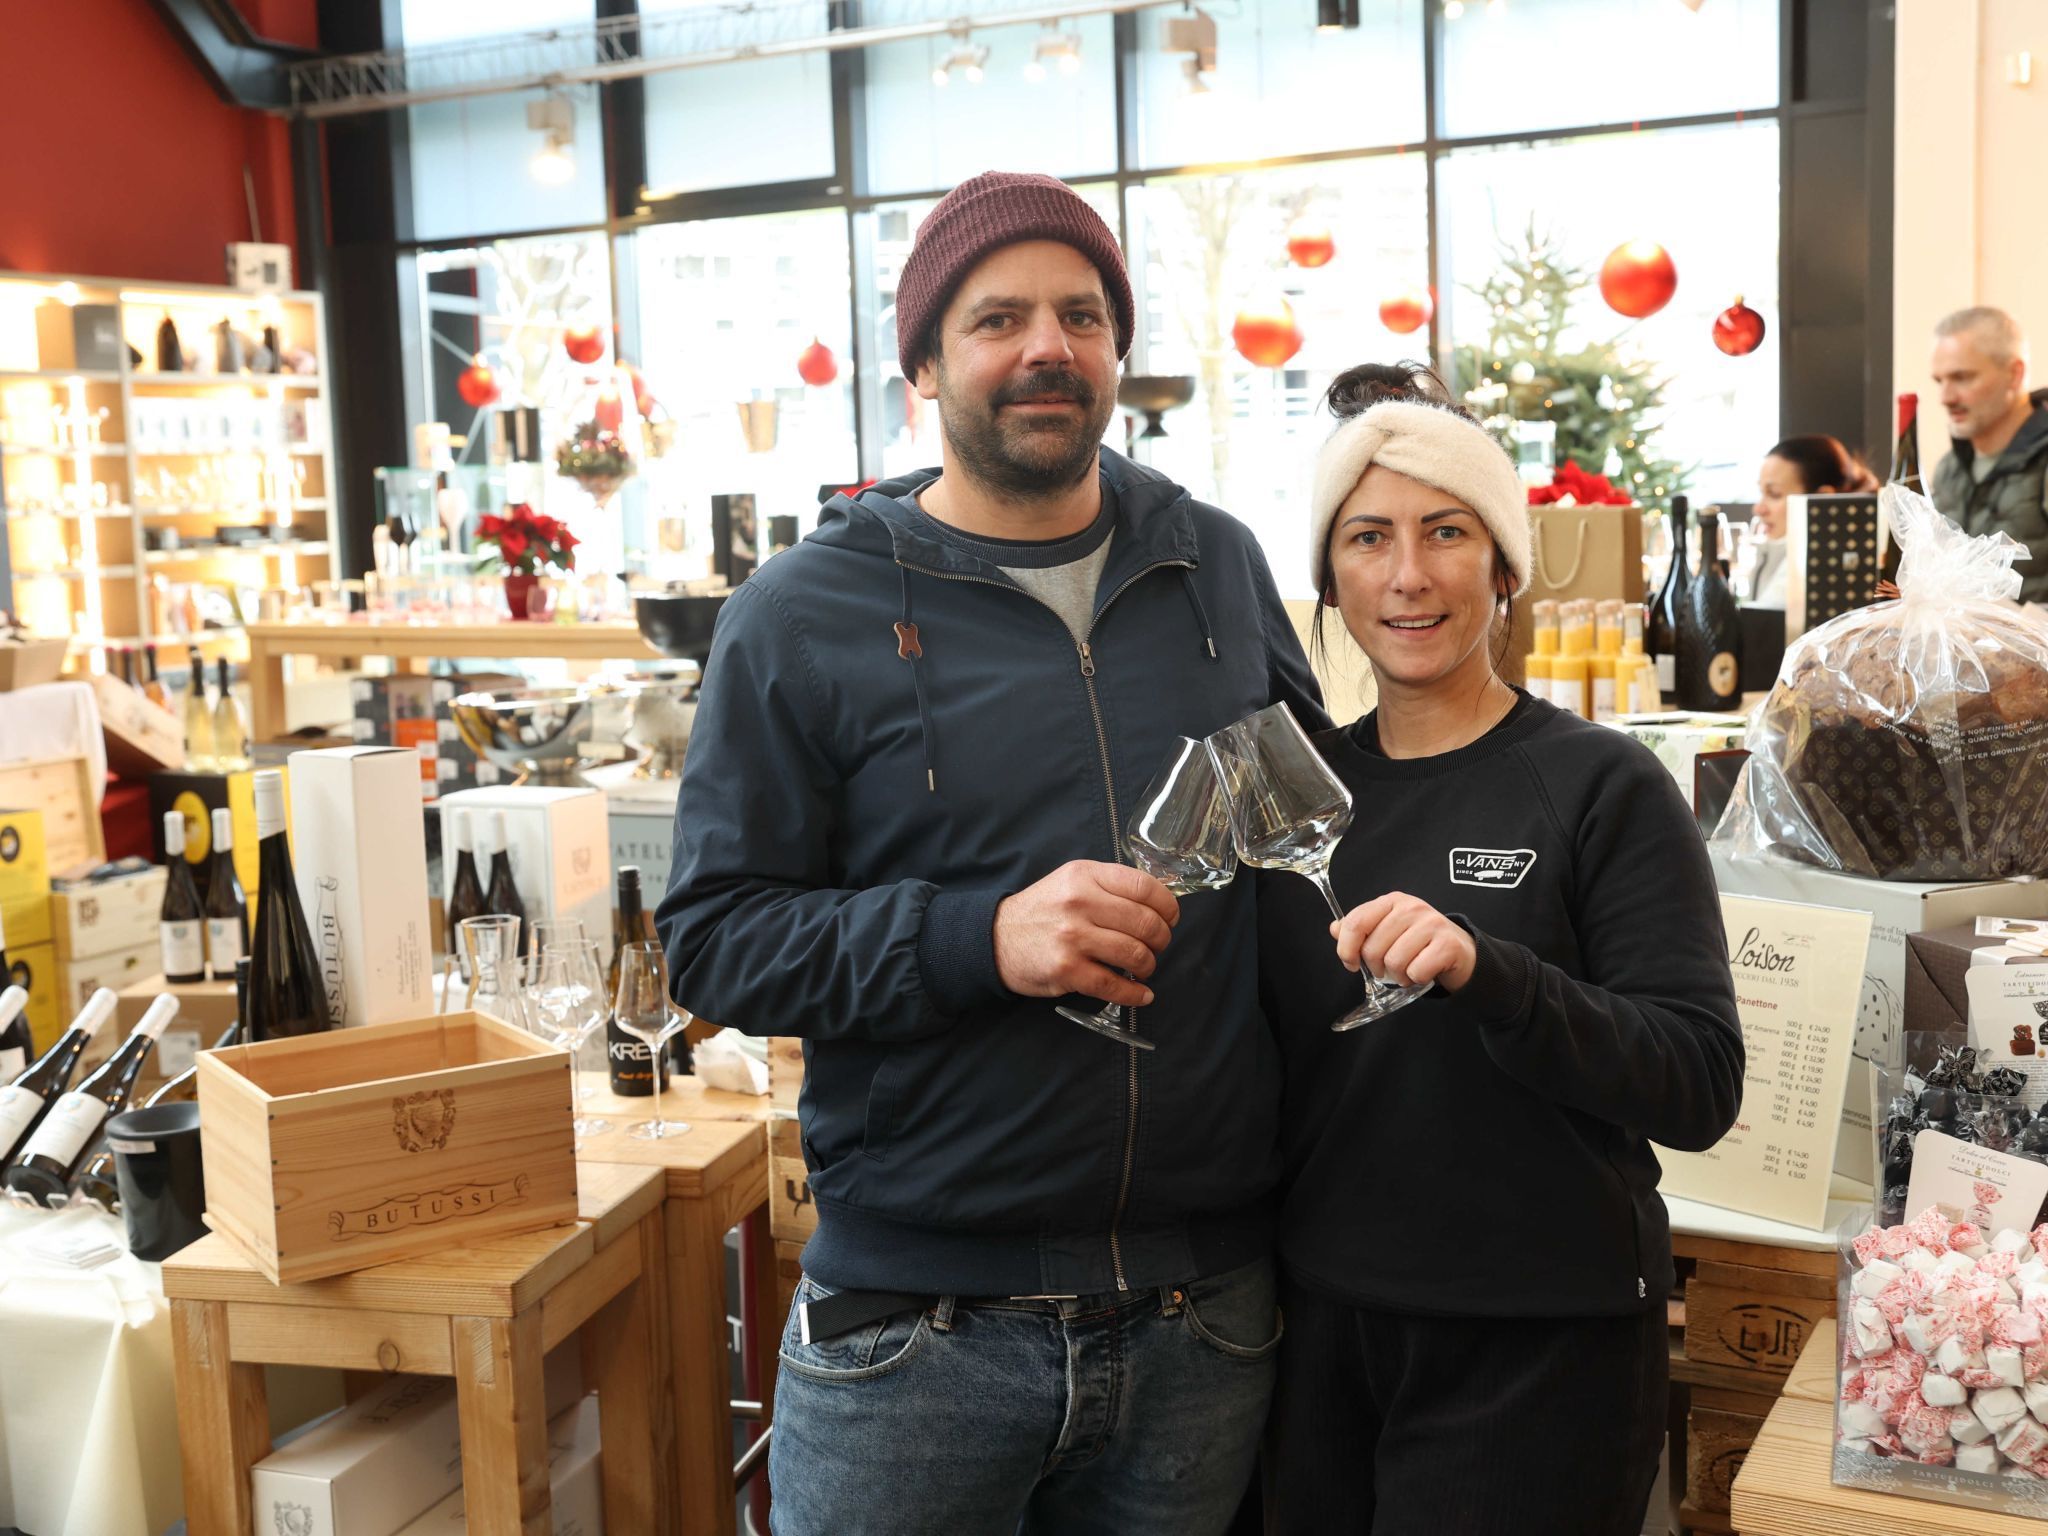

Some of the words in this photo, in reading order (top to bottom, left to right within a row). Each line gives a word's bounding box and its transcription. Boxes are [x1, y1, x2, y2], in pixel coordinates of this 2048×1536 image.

[1968, 733, 1999, 744] QUANTO
[1968, 751, 1988, 760] EVER
[1990, 745, 2026, 757] GROWING
[1466, 853, 1517, 870] VANS
[1730, 927, 1796, 972] Loison
[321, 914, 342, 1025] BUTUSSI
[1780, 977, 1800, 988] 1938
[1736, 995, 1778, 1011] Panettone
[608, 1041, 655, 1061] KRE
[1775, 1093, 1785, 1101] 100
[1773, 1103, 1784, 1112] 100
[1771, 1113, 1782, 1122] 100
[366, 1188, 496, 1229] BUTUSSI
